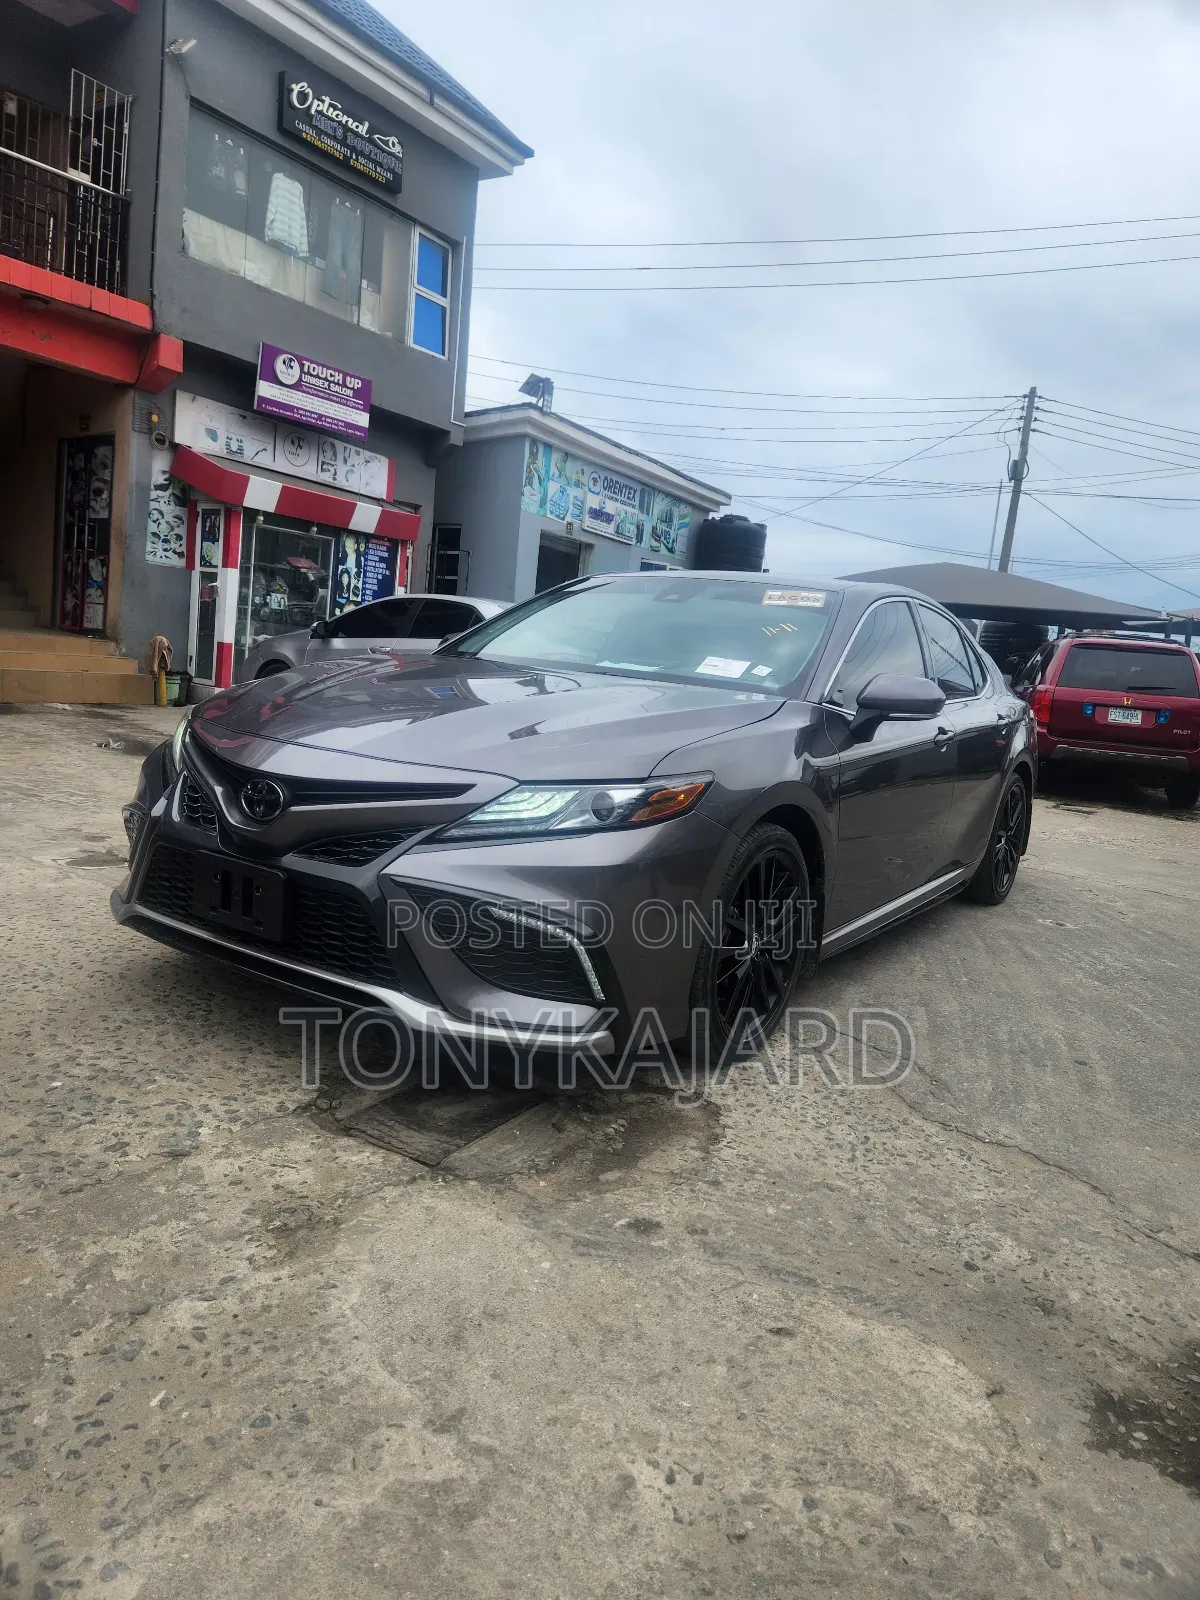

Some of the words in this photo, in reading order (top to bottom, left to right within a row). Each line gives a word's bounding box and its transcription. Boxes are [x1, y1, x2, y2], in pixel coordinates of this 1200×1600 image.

[289, 82, 369, 138] Optional
[313, 112, 343, 139] MEN'S
[346, 132, 402, 174] BOUTIQUE
[321, 135, 350, 156] CORPORATE
[358, 155, 375, 171] SOCIAL
[302, 360, 343, 384] TOUCH
[345, 376, 362, 389] UP
[302, 374, 329, 389] UNISEX
[330, 383, 354, 397] SALON
[603, 476, 638, 502] ORENTEX
